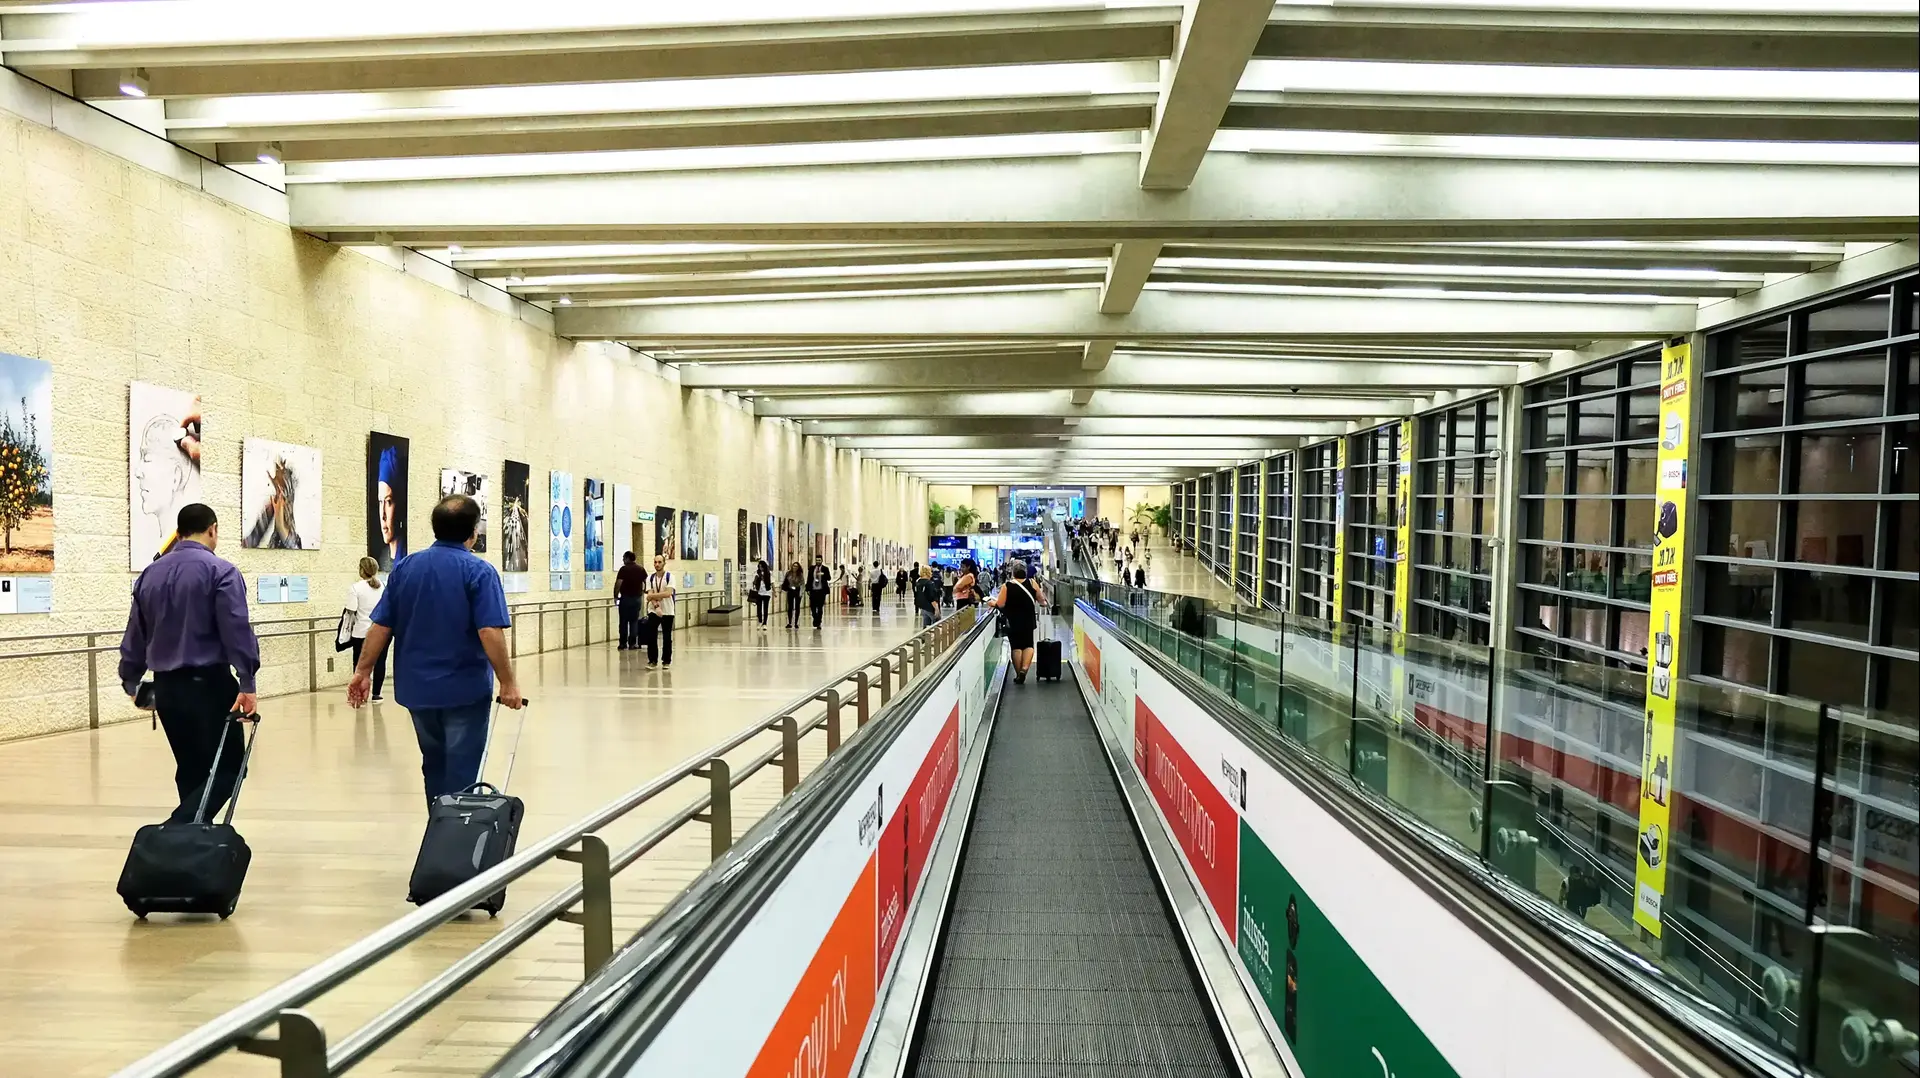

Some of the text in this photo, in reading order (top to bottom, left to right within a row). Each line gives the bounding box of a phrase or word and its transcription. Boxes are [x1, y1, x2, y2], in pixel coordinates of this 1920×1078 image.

[1662, 381, 1686, 399] DUTY FREE
[1654, 572, 1677, 584] DUTY FREE
[1243, 894, 1273, 975] inissia
